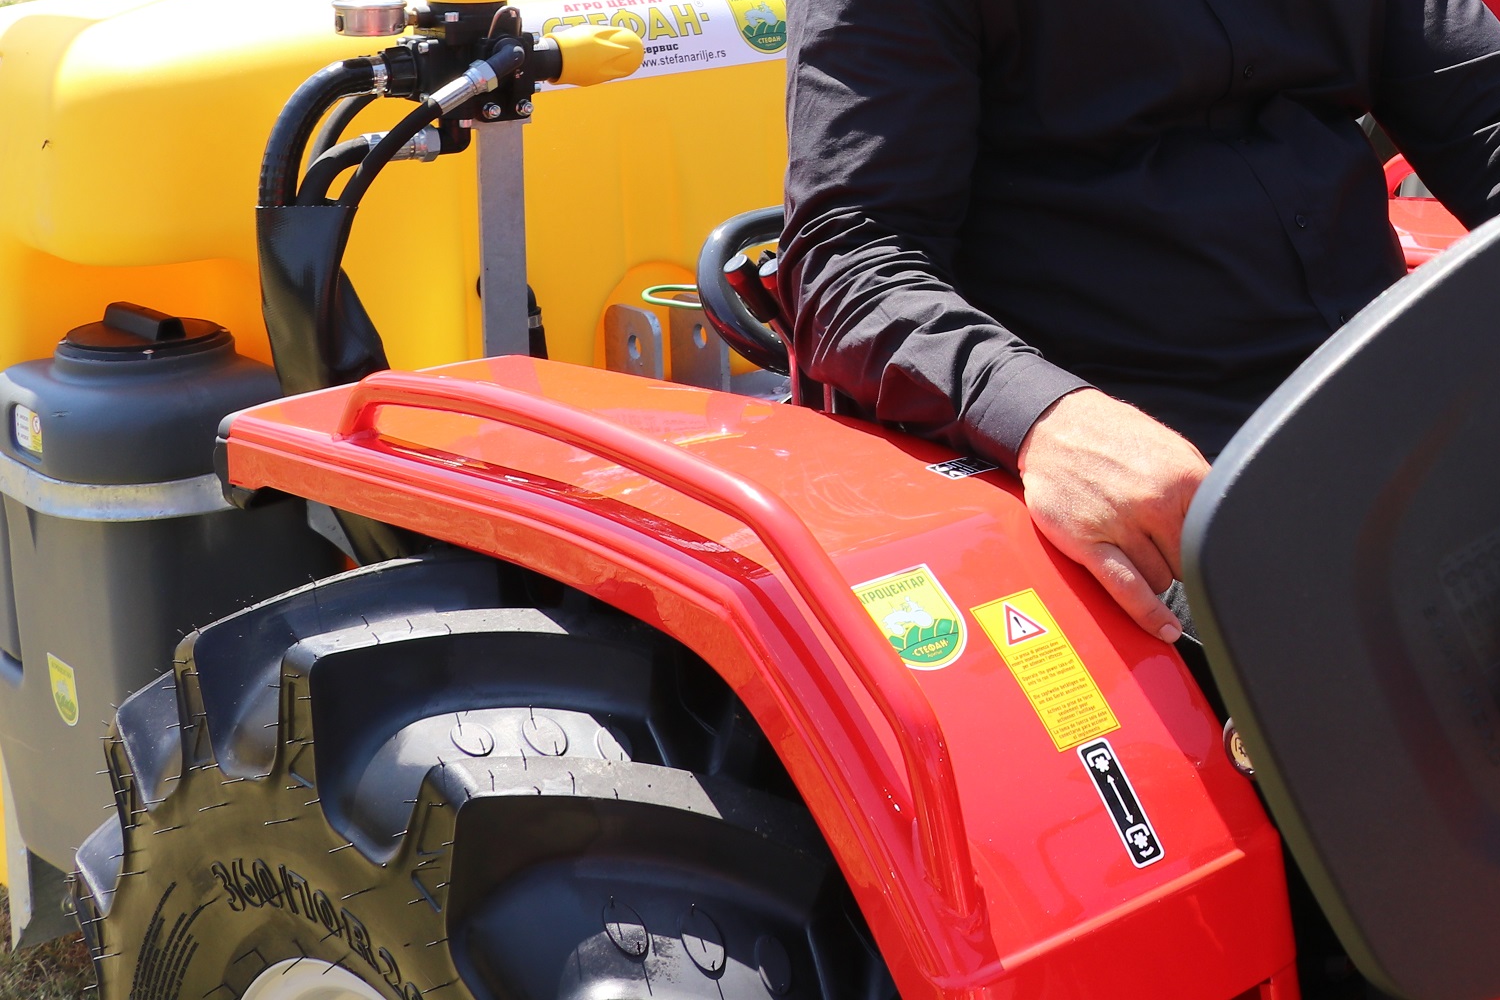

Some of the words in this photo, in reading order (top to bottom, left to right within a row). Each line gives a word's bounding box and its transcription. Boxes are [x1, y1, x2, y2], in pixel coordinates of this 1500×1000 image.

[563, 1, 603, 13] АГРО
[640, 48, 727, 68] ww.stefanarilje.rs
[913, 639, 948, 656] СТЕФАН
